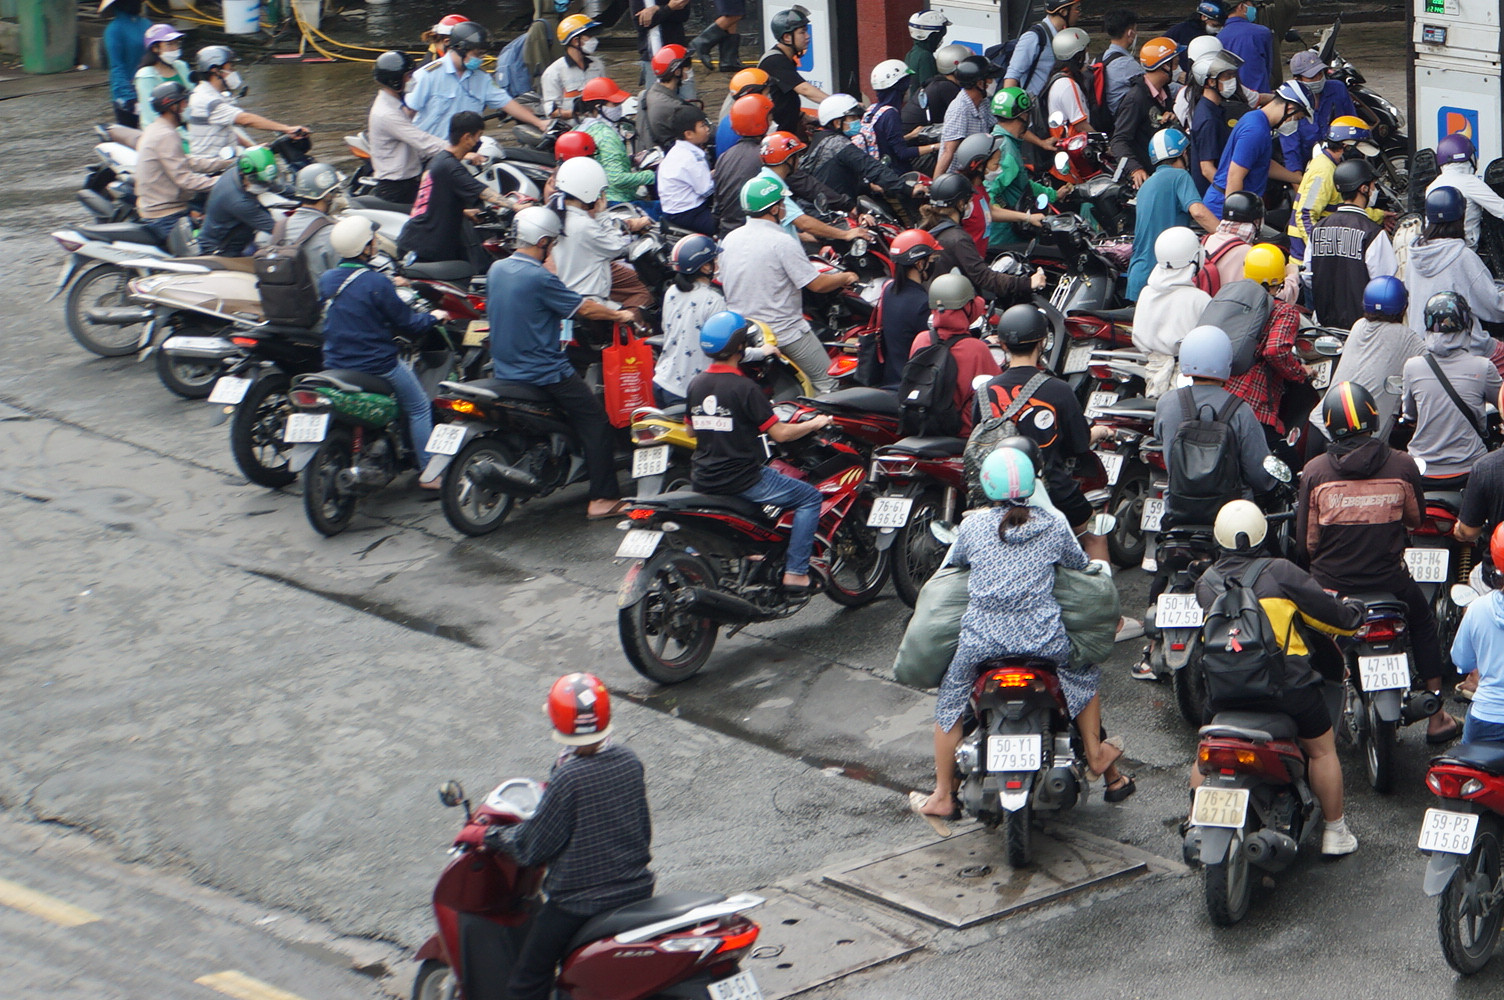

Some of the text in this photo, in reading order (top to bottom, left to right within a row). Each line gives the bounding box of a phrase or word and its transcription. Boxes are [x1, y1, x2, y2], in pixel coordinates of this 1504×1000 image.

[1410, 552, 1440, 565] 93-H4
[1165, 597, 1197, 610] 50-N2
[1162, 611, 1199, 625] 147.59
[1367, 657, 1400, 672] 47-H1
[1363, 671, 1407, 688] 726.01
[997, 738, 1032, 752] 50-Y1
[993, 753, 1036, 769] 779.56
[1204, 791, 1240, 807] 76-Z1
[1432, 814, 1470, 833] 59-P3
[1424, 831, 1470, 851] 115.68
